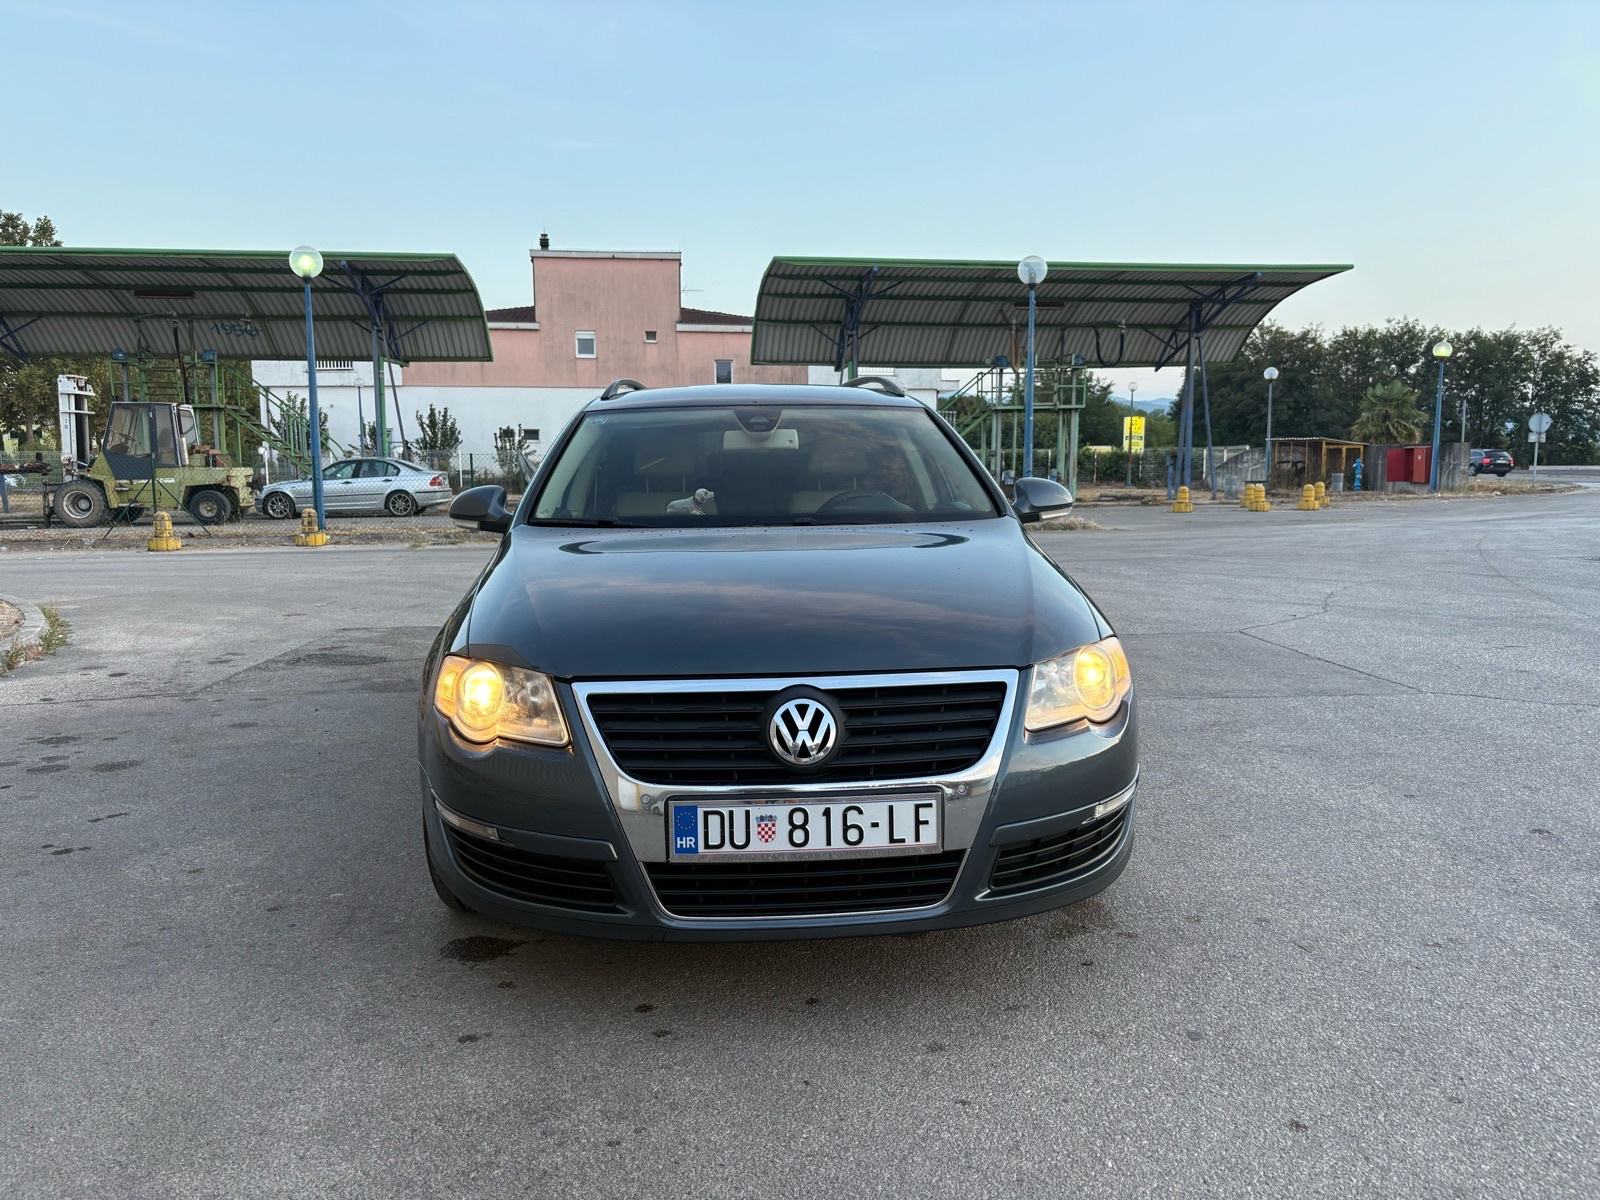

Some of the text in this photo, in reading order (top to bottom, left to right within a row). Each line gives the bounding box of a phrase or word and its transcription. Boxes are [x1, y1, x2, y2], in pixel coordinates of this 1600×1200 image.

[770, 699, 836, 764] VW
[676, 836, 696, 849] HR
[703, 803, 934, 850] DU 816-LF
